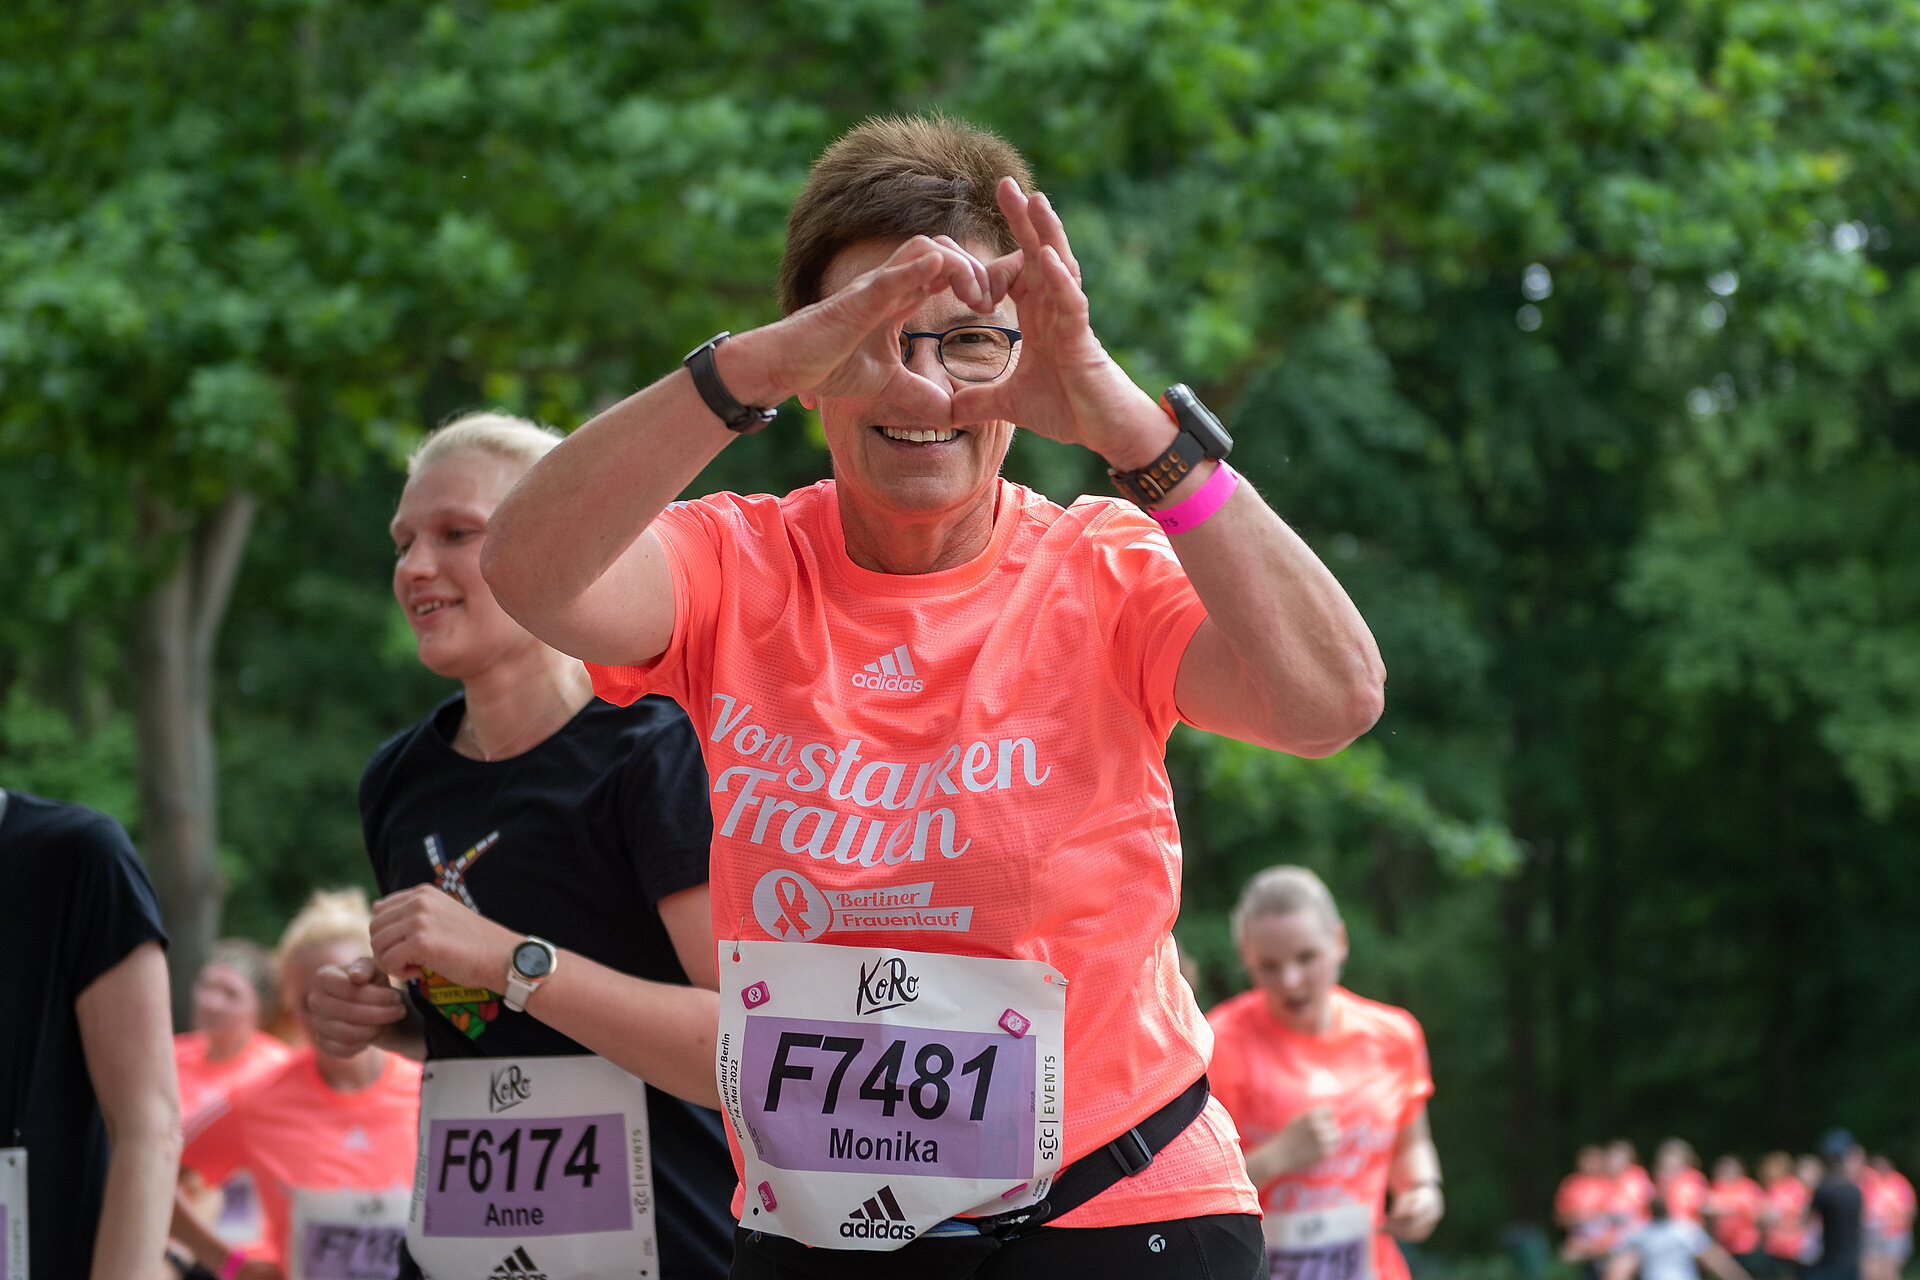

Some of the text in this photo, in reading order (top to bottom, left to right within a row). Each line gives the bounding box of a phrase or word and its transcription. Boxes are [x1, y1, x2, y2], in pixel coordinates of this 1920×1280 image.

[851, 673, 924, 693] adidas
[710, 693, 1051, 811] Von starken
[713, 766, 972, 868] Frauen
[836, 890, 920, 908] Berliner
[842, 912, 959, 929] Frauenlauf
[856, 956, 920, 1016] KoRo
[720, 1033, 731, 1062] Berlin
[730, 1059, 739, 1082] 2022
[763, 1031, 999, 1122] F7481
[730, 1083, 739, 1105] Mai
[1041, 1055, 1056, 1160] SCC EVENTS
[438, 1124, 600, 1194] F6174
[632, 1129, 645, 1180] EVENTS
[829, 1127, 939, 1164] Monika
[484, 1203, 545, 1228] Anne
[839, 1219, 917, 1241] adidas
